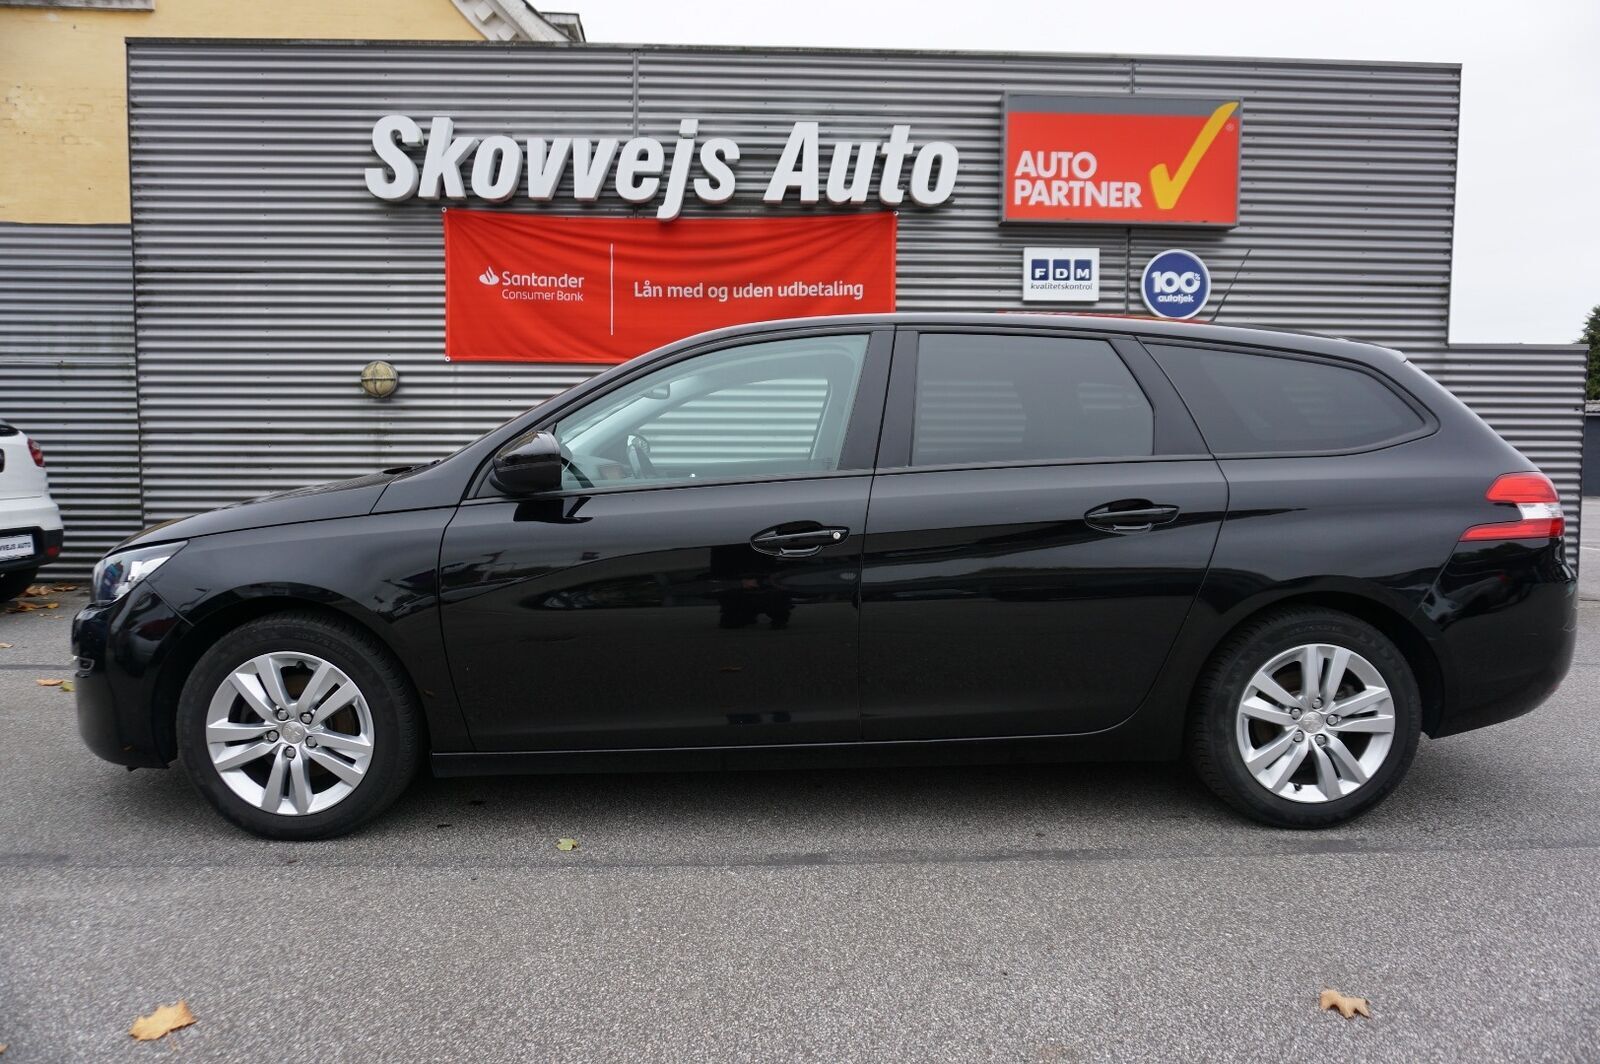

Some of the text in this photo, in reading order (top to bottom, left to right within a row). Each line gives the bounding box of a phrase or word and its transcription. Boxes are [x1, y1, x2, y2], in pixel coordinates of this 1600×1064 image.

[364, 115, 961, 222] Skovvejs Auto
[1014, 150, 1097, 179] AUTO
[1014, 179, 1142, 208] PARTNER
[501, 271, 585, 288] Santander
[1033, 266, 1090, 280] FDM
[501, 289, 584, 302] Consumer Bank
[634, 280, 864, 302] Lån med og uden udbetaling
